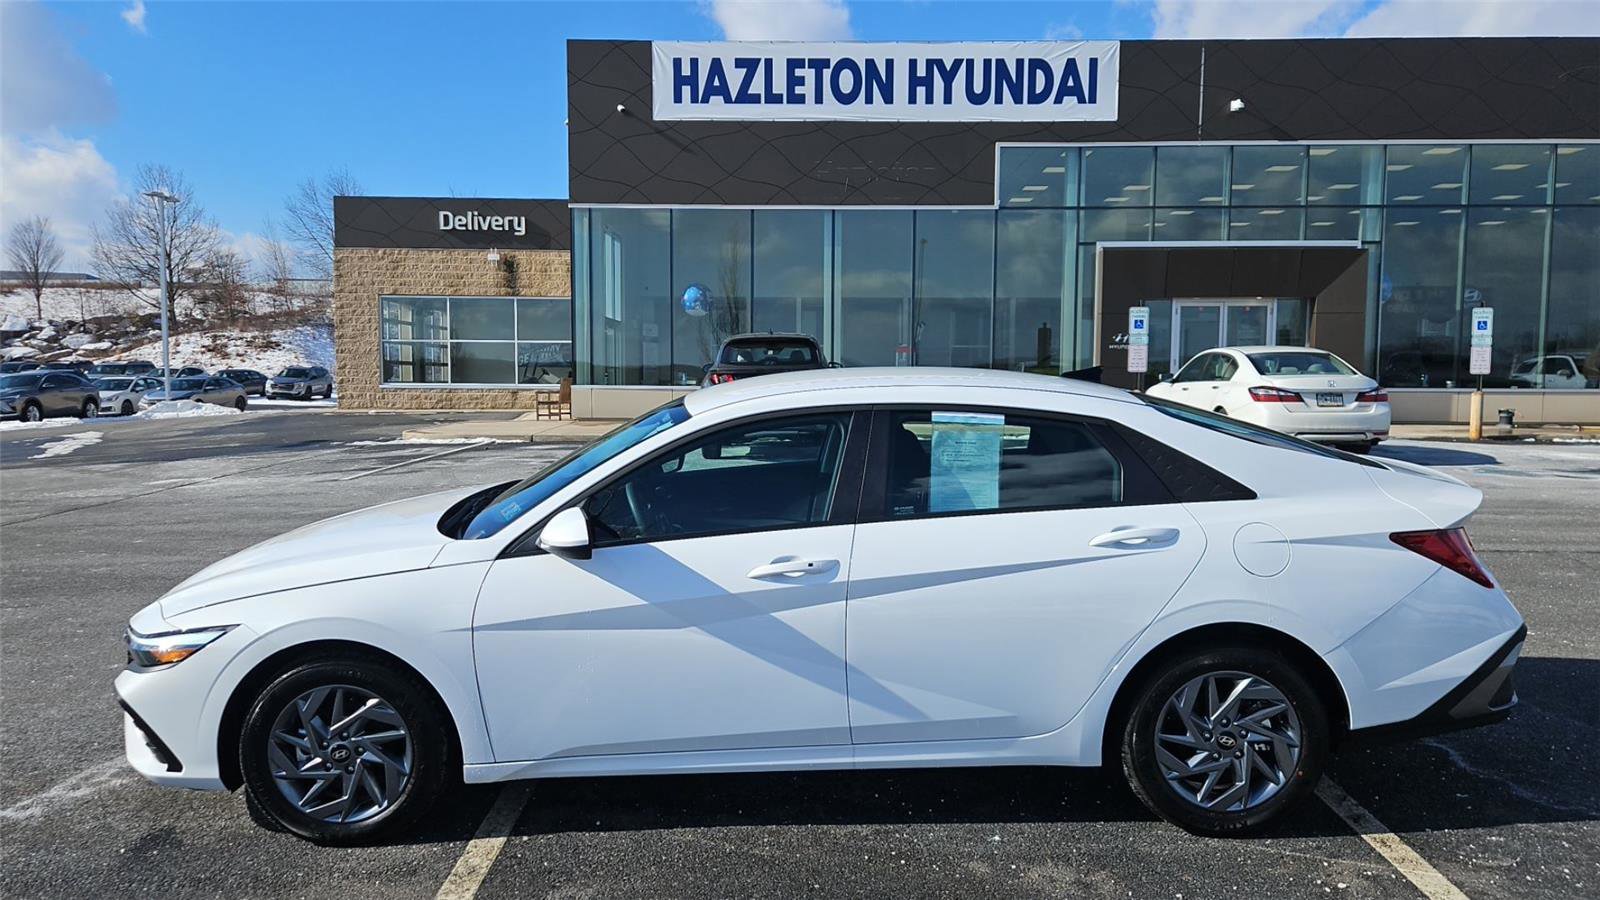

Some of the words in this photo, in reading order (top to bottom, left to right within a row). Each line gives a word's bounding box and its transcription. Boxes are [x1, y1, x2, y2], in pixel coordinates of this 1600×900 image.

[673, 57, 895, 105] HAZLETON
[907, 57, 1099, 105] HYUNDAI
[438, 210, 526, 236] Delivery
